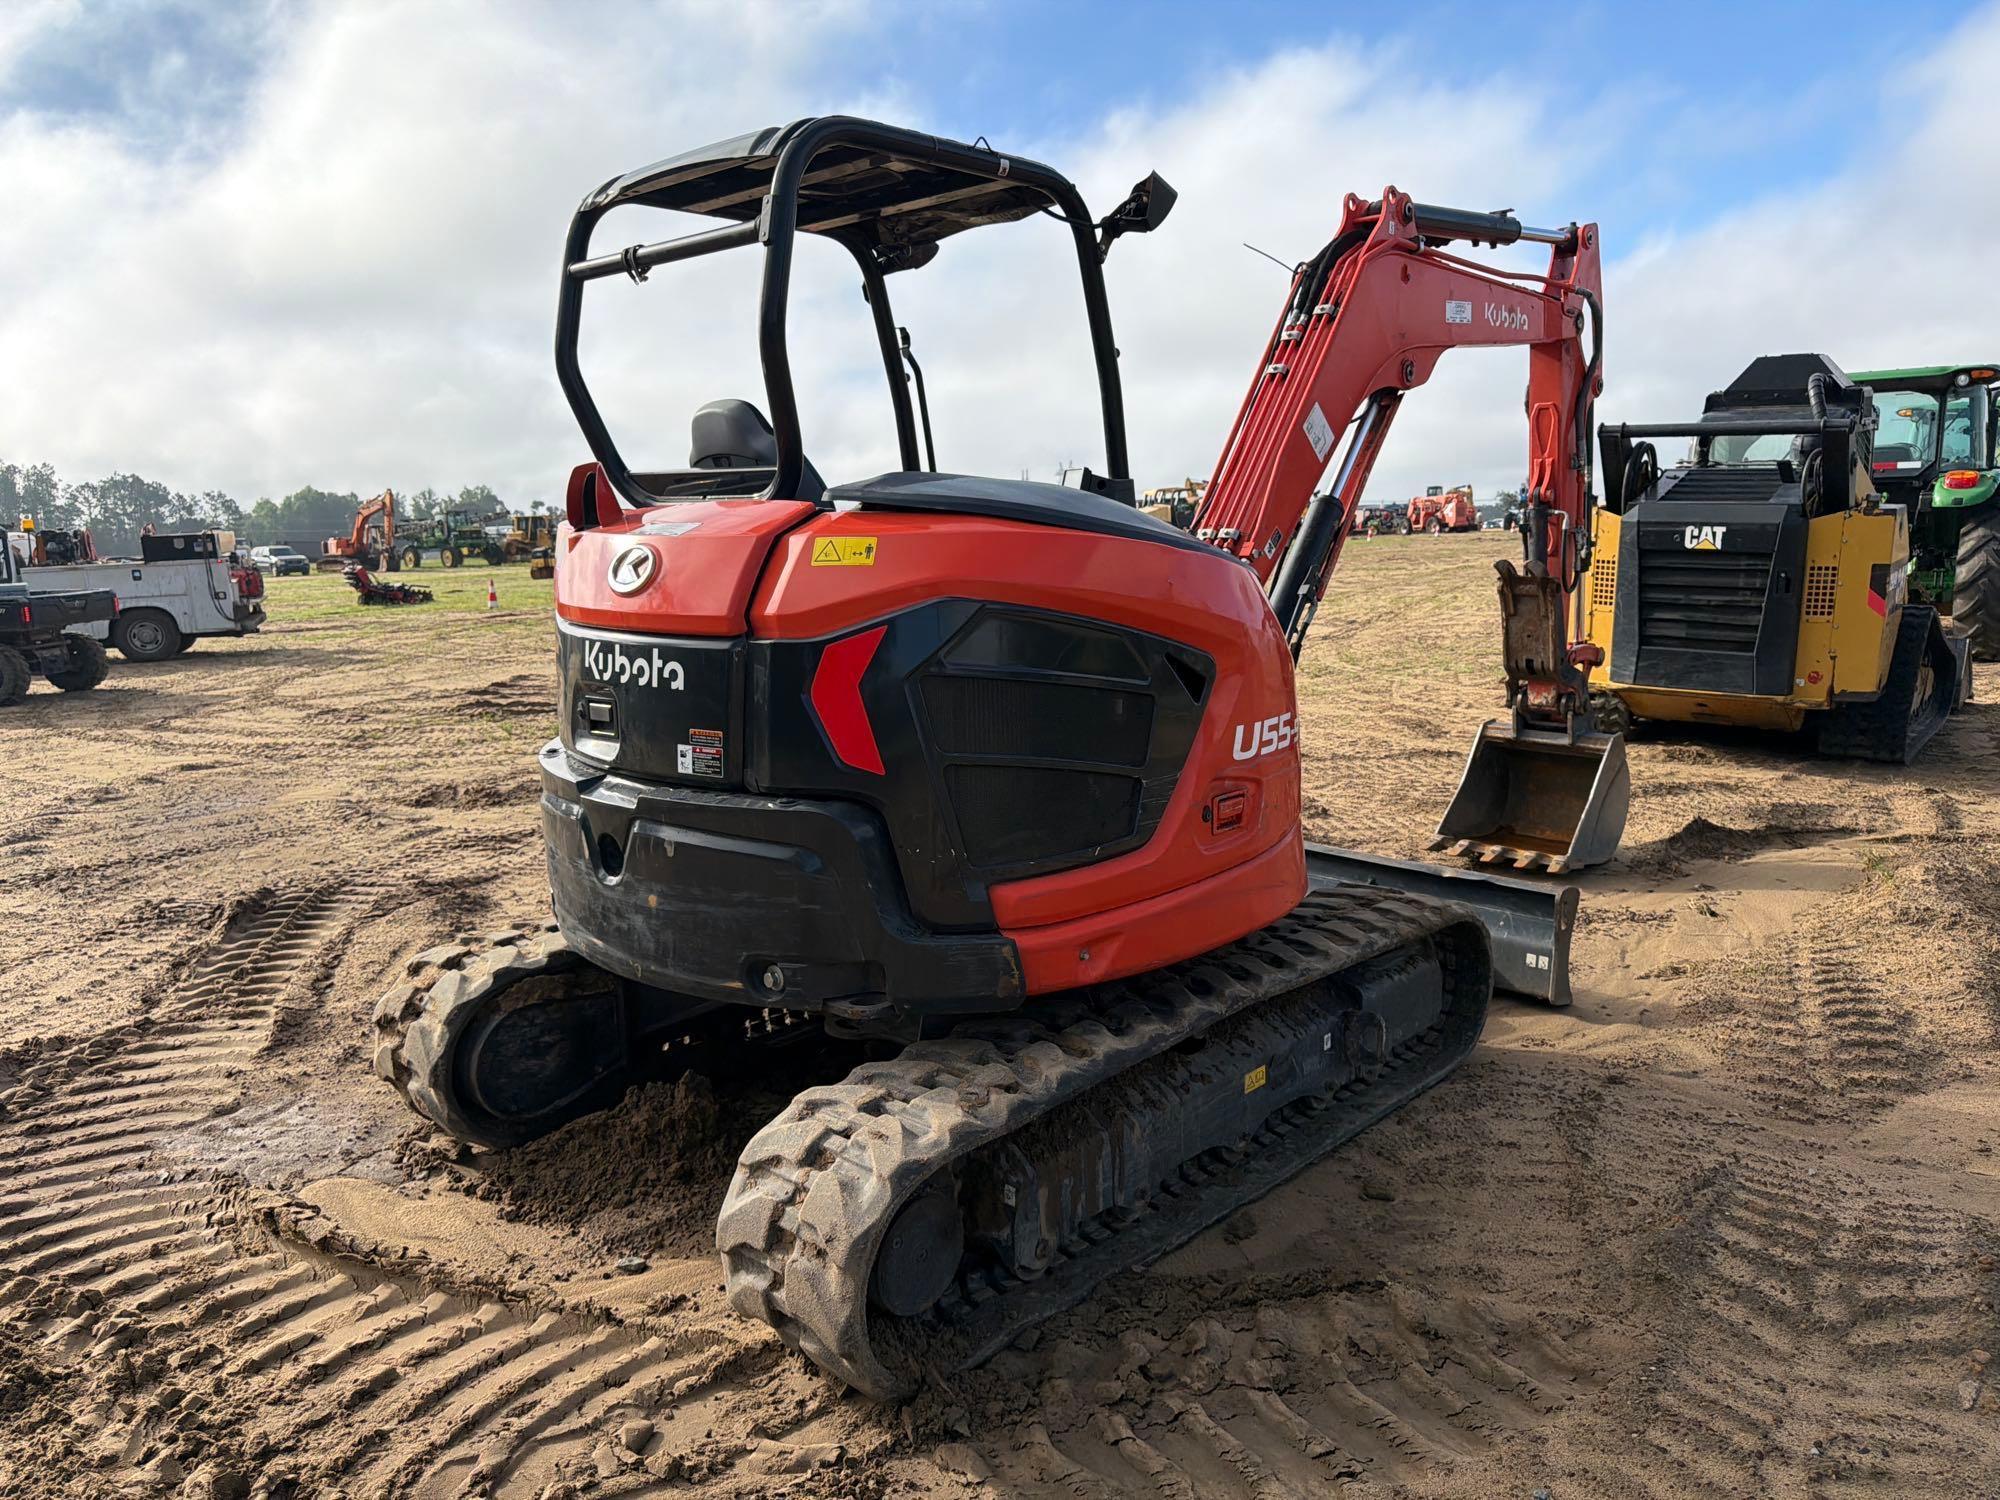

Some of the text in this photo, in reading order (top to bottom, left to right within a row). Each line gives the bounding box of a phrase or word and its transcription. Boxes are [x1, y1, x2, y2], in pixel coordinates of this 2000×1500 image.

[1485, 302, 1528, 330] Kubota
[1685, 525, 1727, 550] CAT
[585, 640, 684, 690] Kubota
